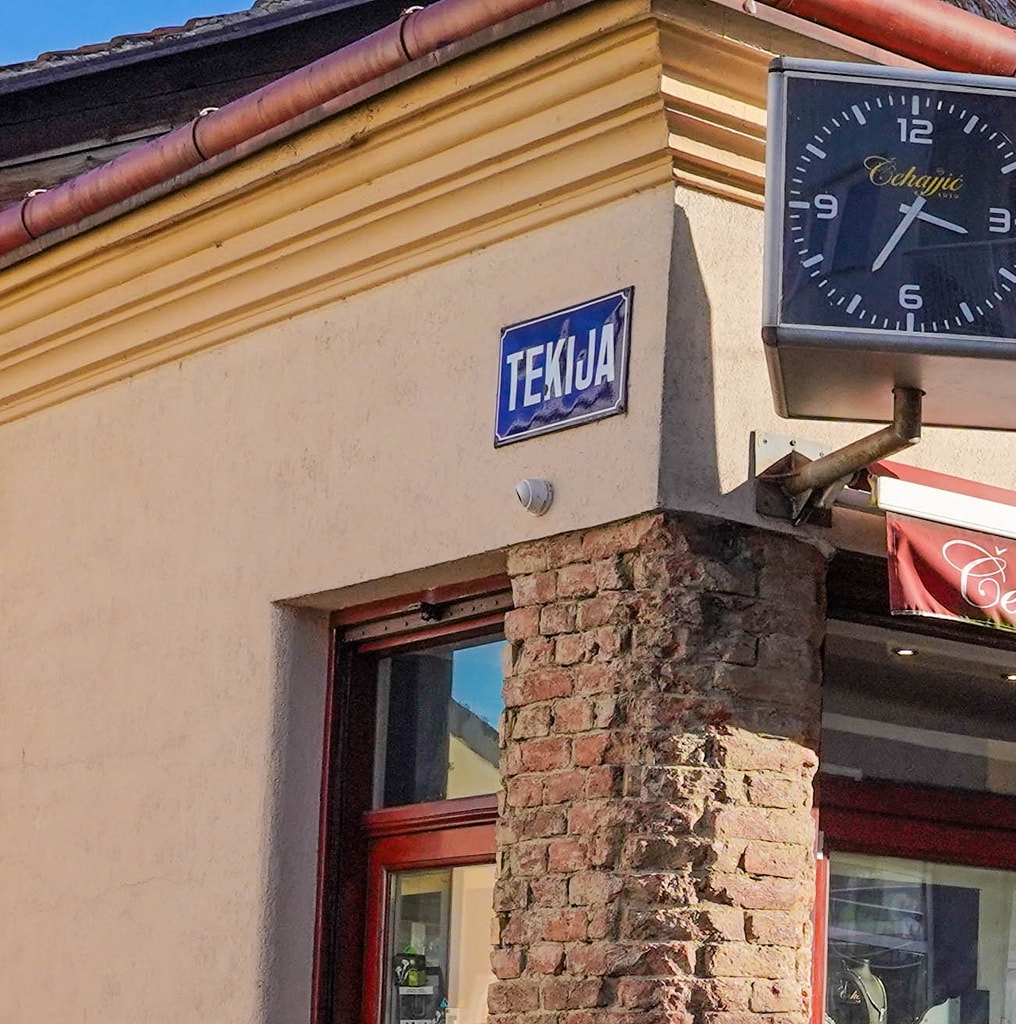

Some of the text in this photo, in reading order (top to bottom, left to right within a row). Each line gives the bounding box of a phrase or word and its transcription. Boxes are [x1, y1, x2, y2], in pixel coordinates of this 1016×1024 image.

[897, 117, 933, 144] 12
[814, 194, 838, 219] 9
[988, 207, 1011, 233] 3
[898, 284, 923, 310] 6
[506, 323, 615, 412] TEKIJA
